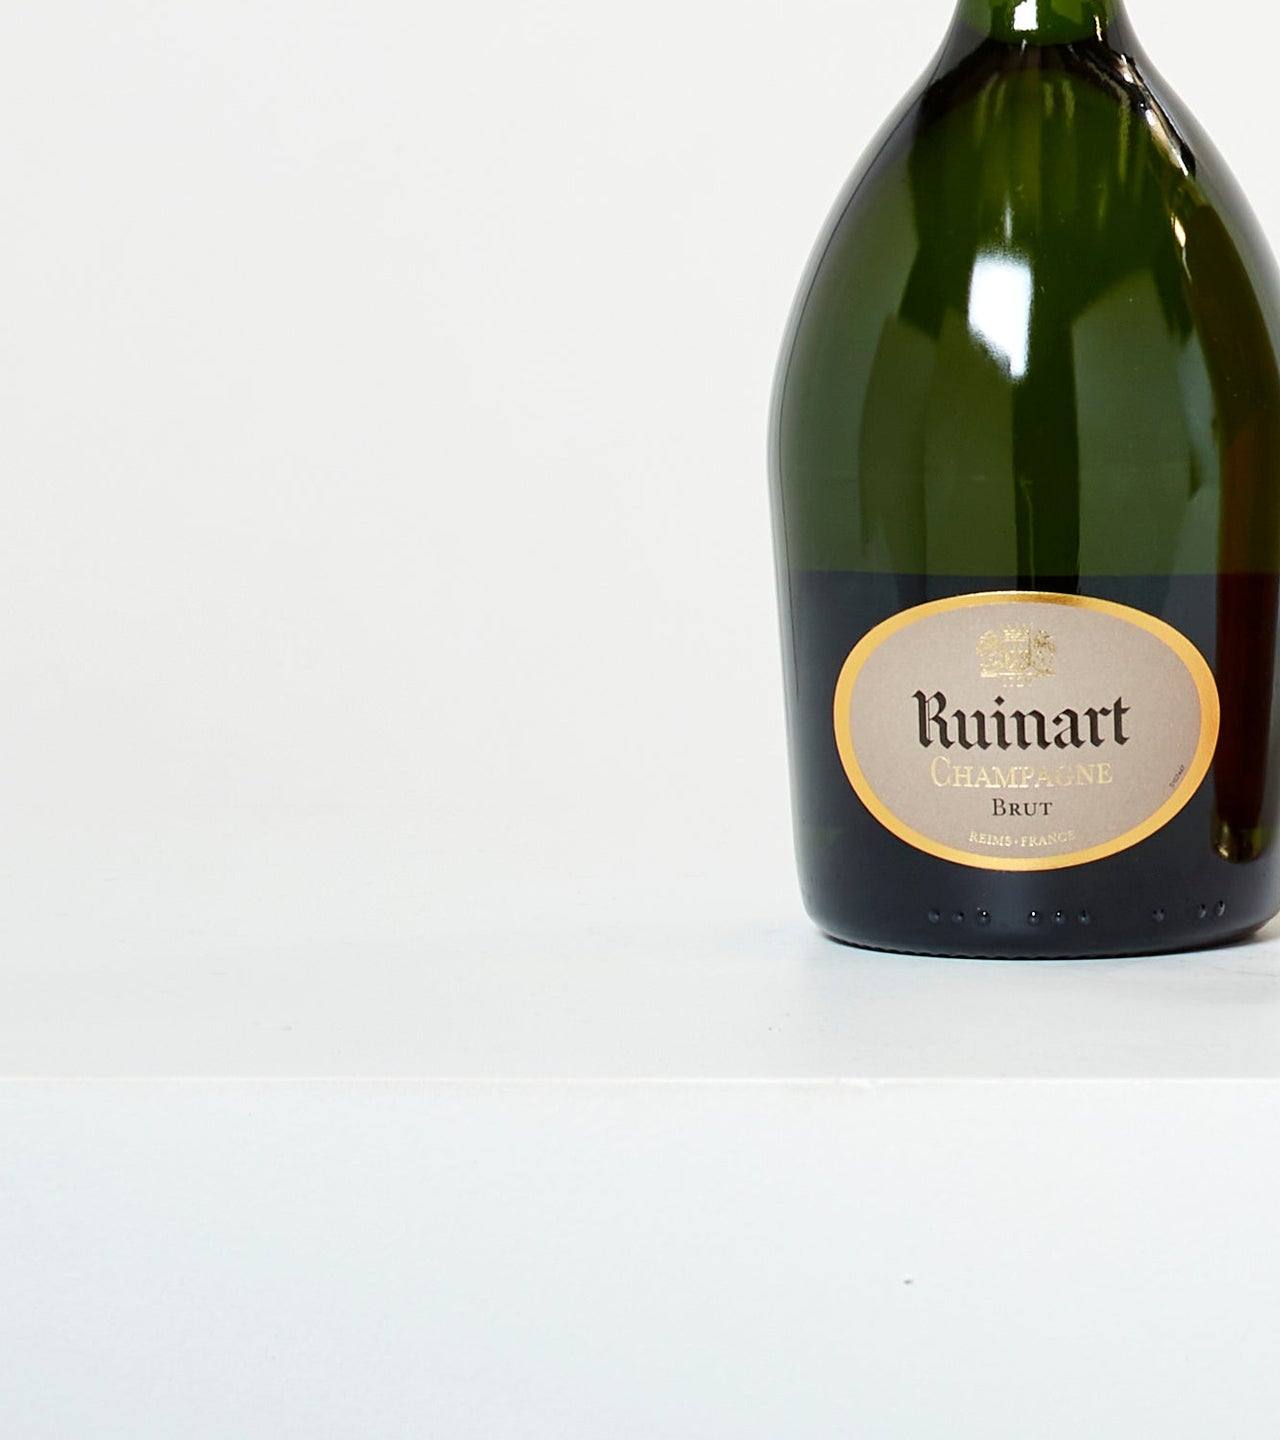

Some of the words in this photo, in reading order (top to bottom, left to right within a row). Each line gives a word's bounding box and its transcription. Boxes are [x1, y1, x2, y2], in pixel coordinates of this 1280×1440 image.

[911, 689, 1131, 751] Ruinart
[930, 755, 1113, 789] CHAMPAGNE
[991, 797, 1053, 817] BRUT
[968, 830, 1012, 847] REIMS
[1020, 829, 1077, 847] FRANCE
